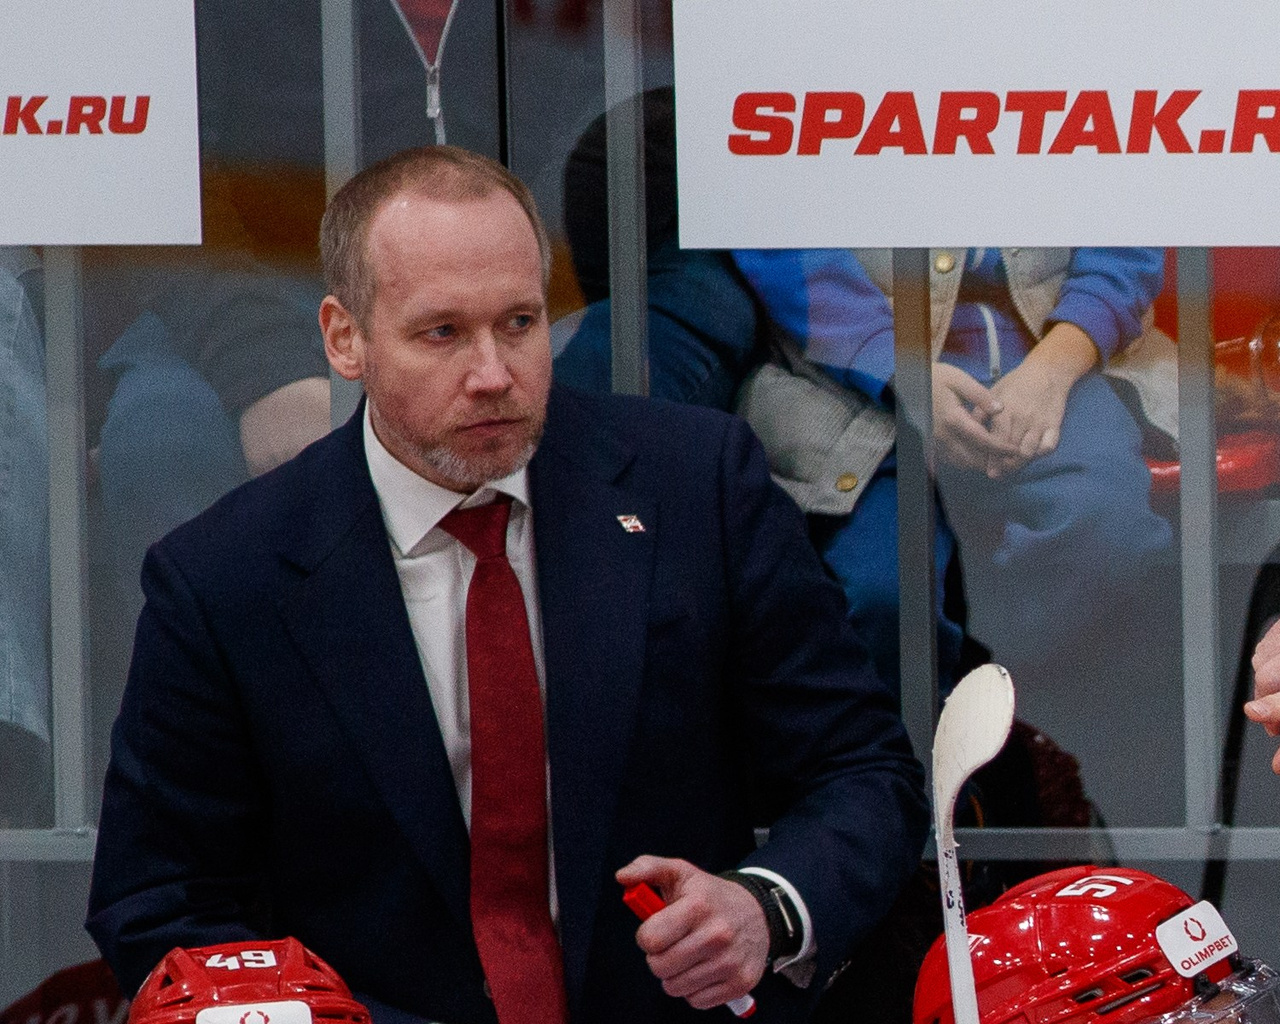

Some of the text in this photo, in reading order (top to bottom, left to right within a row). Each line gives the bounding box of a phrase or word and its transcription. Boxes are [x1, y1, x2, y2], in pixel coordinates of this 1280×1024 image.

[2, 95, 151, 136] K.RU
[205, 949, 277, 971] 49
[1180, 934, 1233, 972] OLIMPBET
